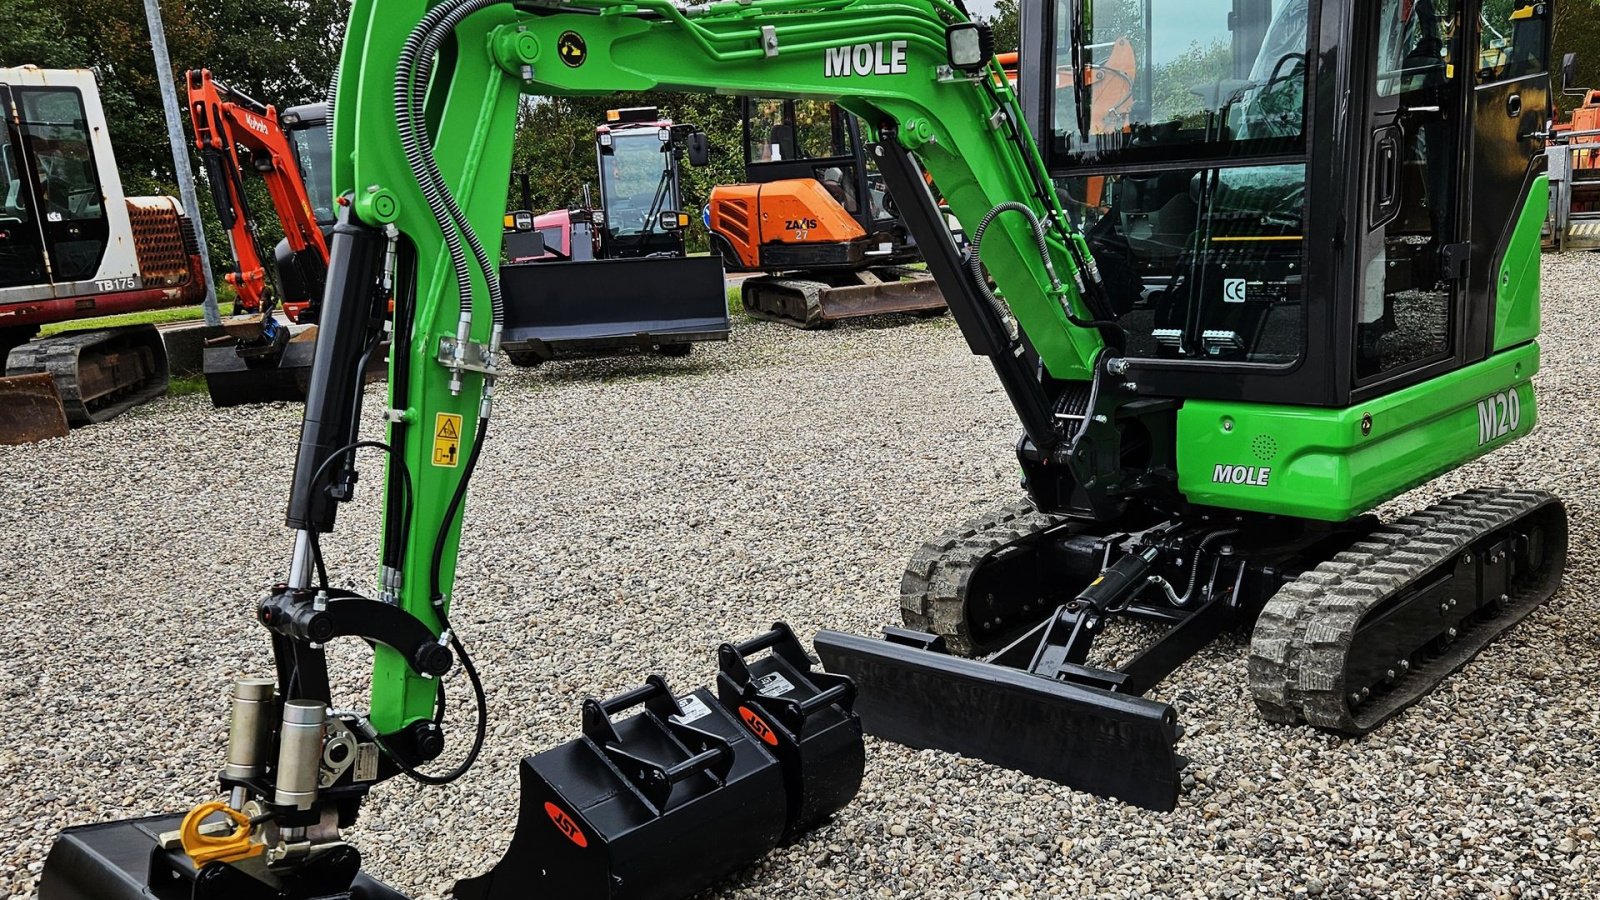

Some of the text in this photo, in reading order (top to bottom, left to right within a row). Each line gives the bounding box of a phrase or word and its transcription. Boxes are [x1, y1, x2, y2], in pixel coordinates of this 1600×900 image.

[824, 40, 907, 77] MOLE
[785, 217, 817, 231] ZAXIS
[795, 230, 808, 240] 27
[95, 277, 135, 292] TB175
[1477, 387, 1520, 446] M20
[1212, 464, 1271, 486] MOLE
[747, 715, 771, 738] JST
[554, 812, 580, 839] JST
